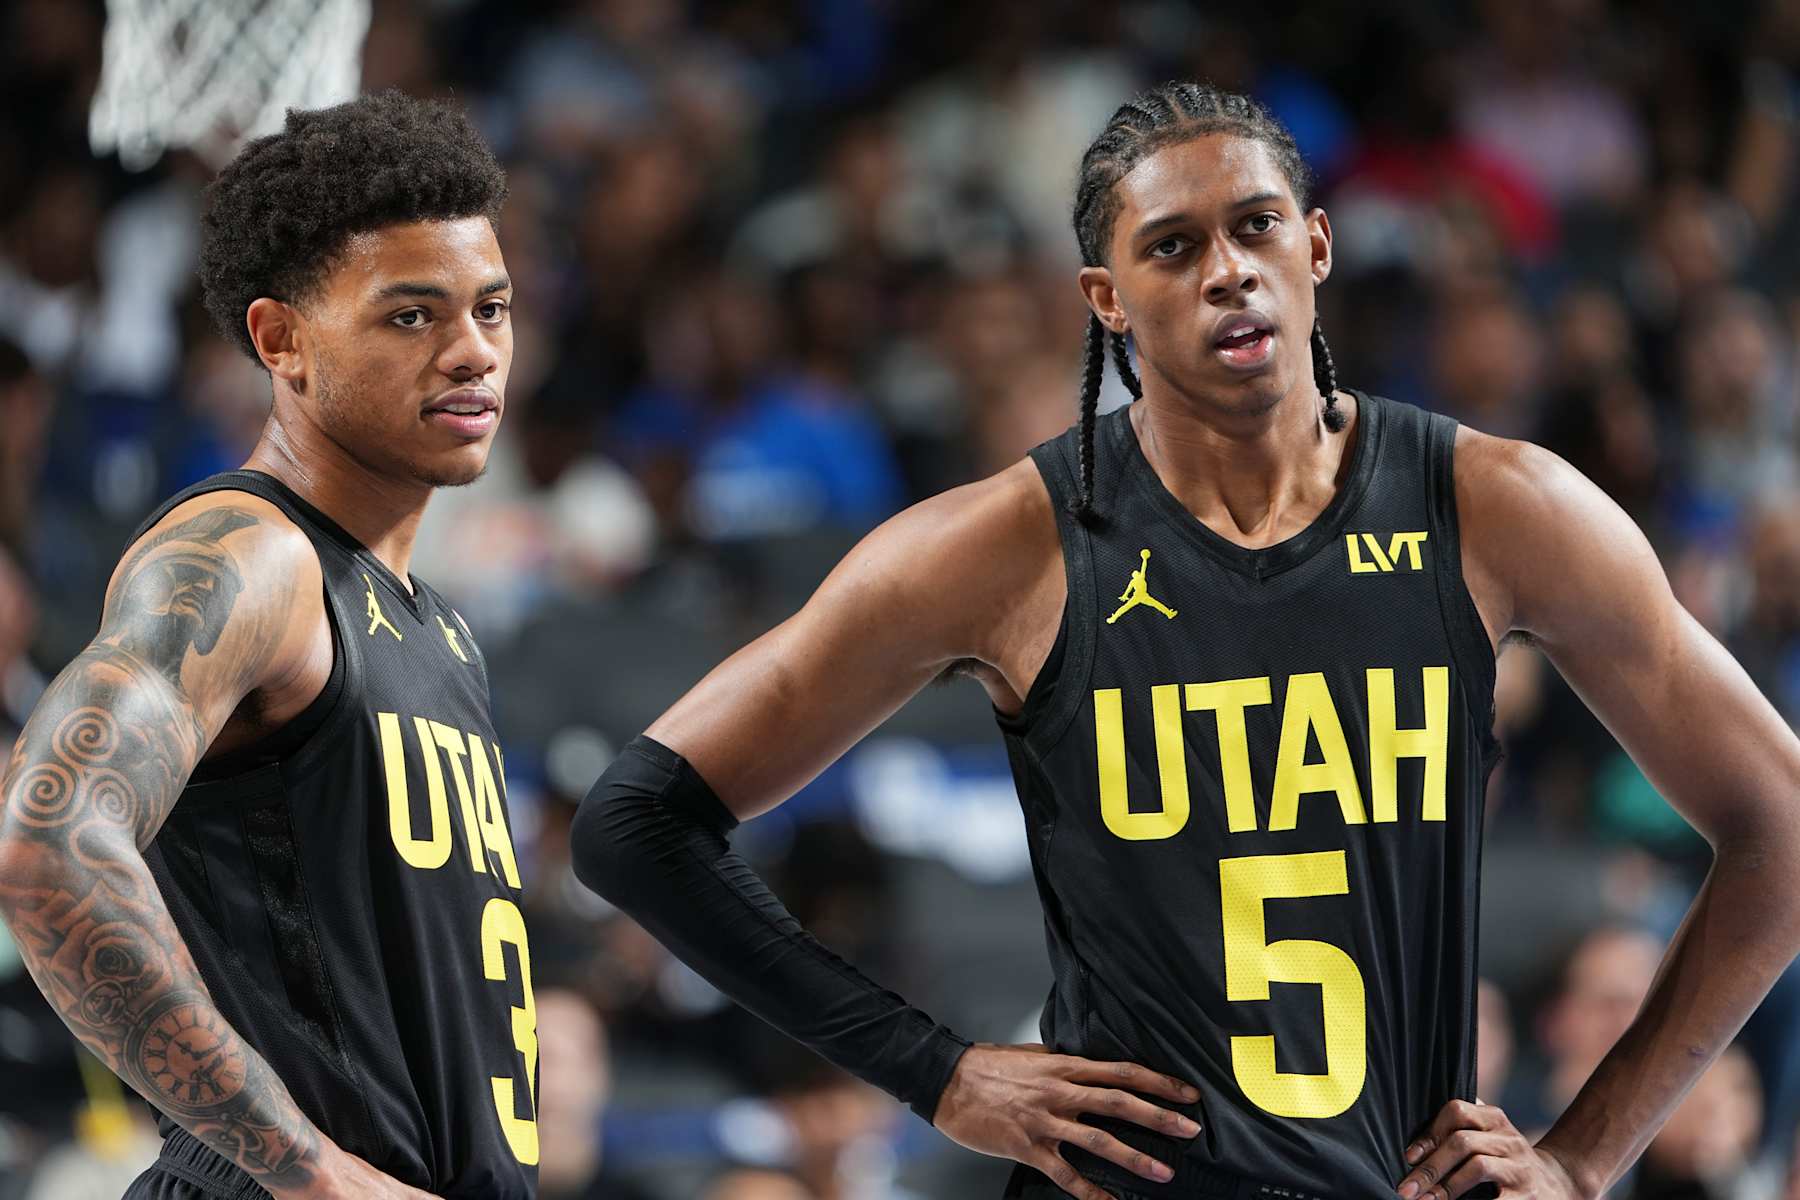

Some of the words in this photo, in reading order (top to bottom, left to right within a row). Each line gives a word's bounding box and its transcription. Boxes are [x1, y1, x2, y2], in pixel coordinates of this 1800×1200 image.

[1346, 531, 1428, 573] LVT
[378, 711, 522, 889] UTA
[1094, 666, 1449, 841] UTAH
[481, 897, 540, 1166] 3
[1219, 849, 1367, 1118] 5
